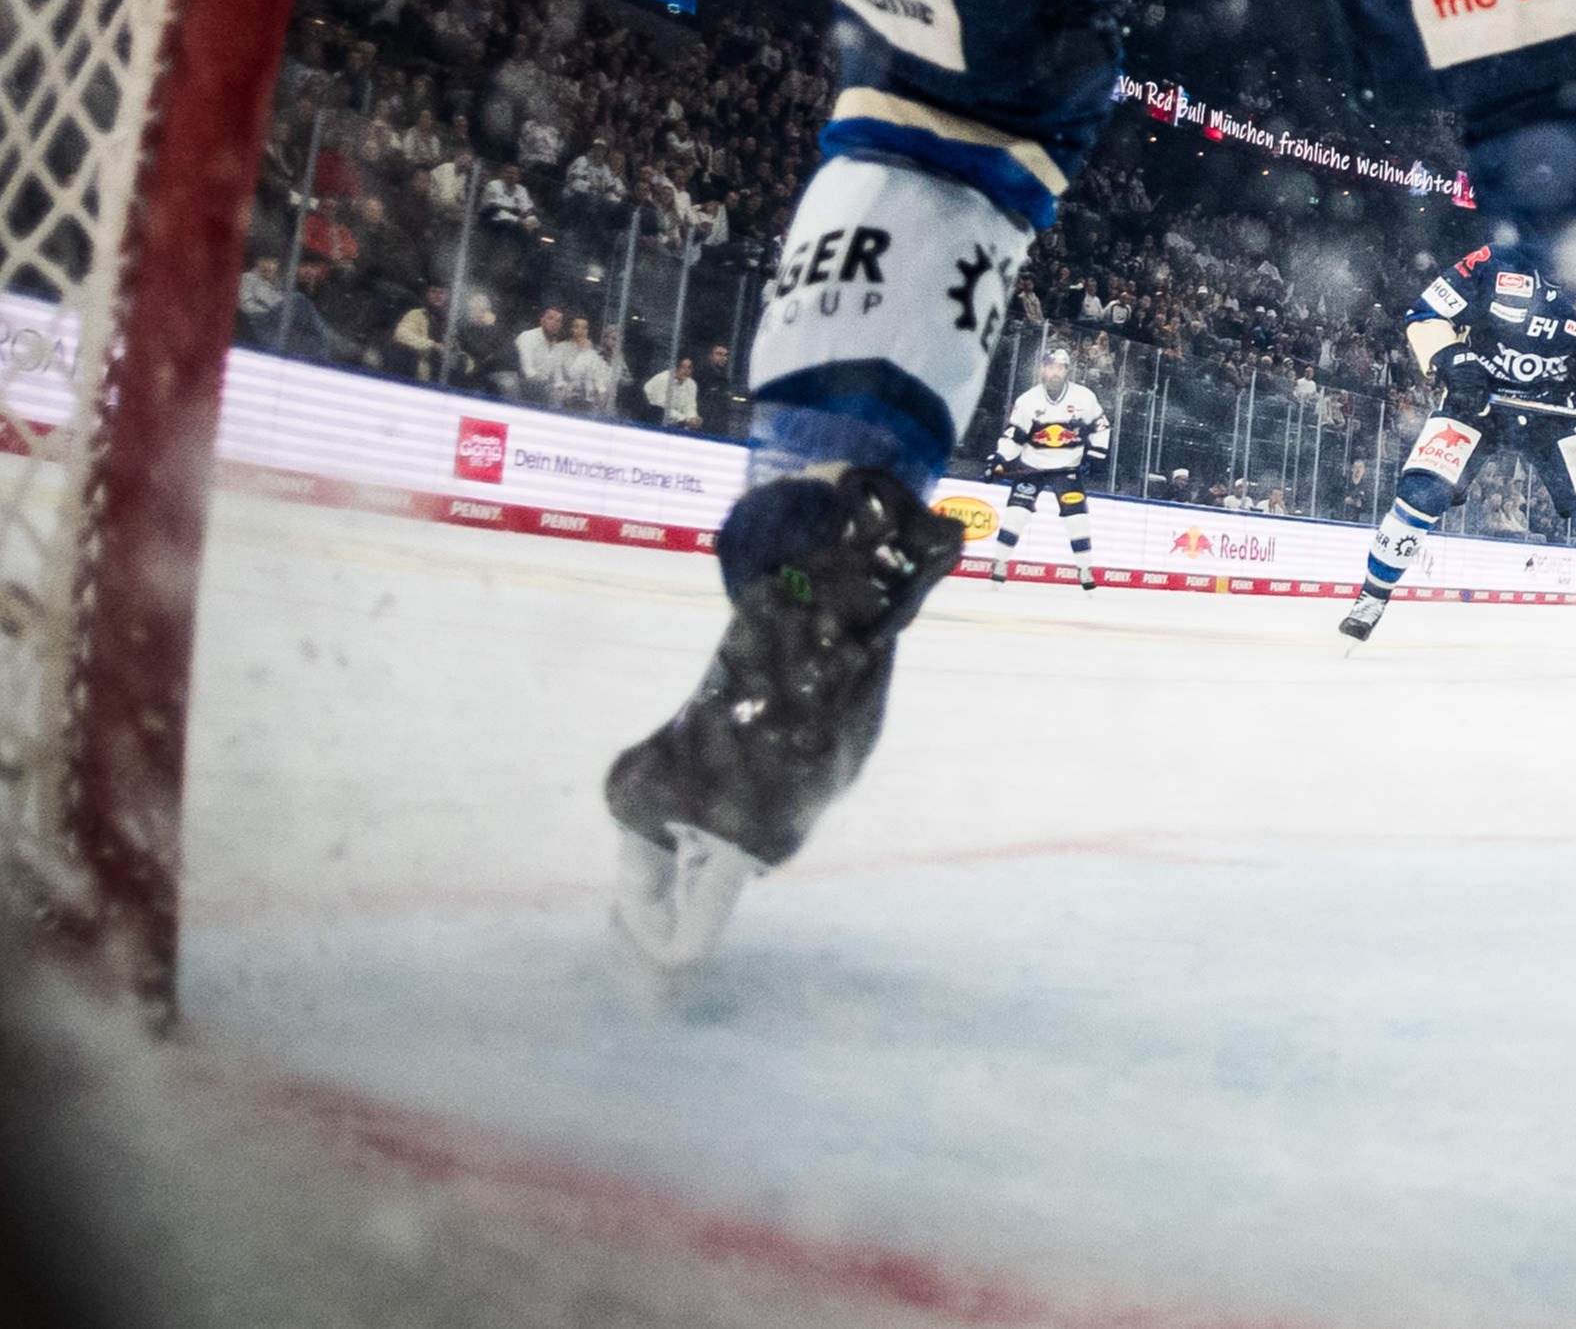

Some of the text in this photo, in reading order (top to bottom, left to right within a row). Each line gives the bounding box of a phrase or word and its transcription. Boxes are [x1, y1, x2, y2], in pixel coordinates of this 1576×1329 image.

[1145, 81, 1173, 112] Red
[1178, 96, 1206, 125] Bull
[1210, 109, 1274, 150] München
[1279, 133, 1350, 172] fröhliche
[776, 226, 891, 299] GER
[782, 290, 883, 325] OUP
[1526, 315, 1558, 340] 64
[514, 448, 551, 470] Dein
[631, 467, 672, 489] Deine
[1425, 446, 1461, 467] ORCA
[1220, 533, 1276, 563] Red Bull
